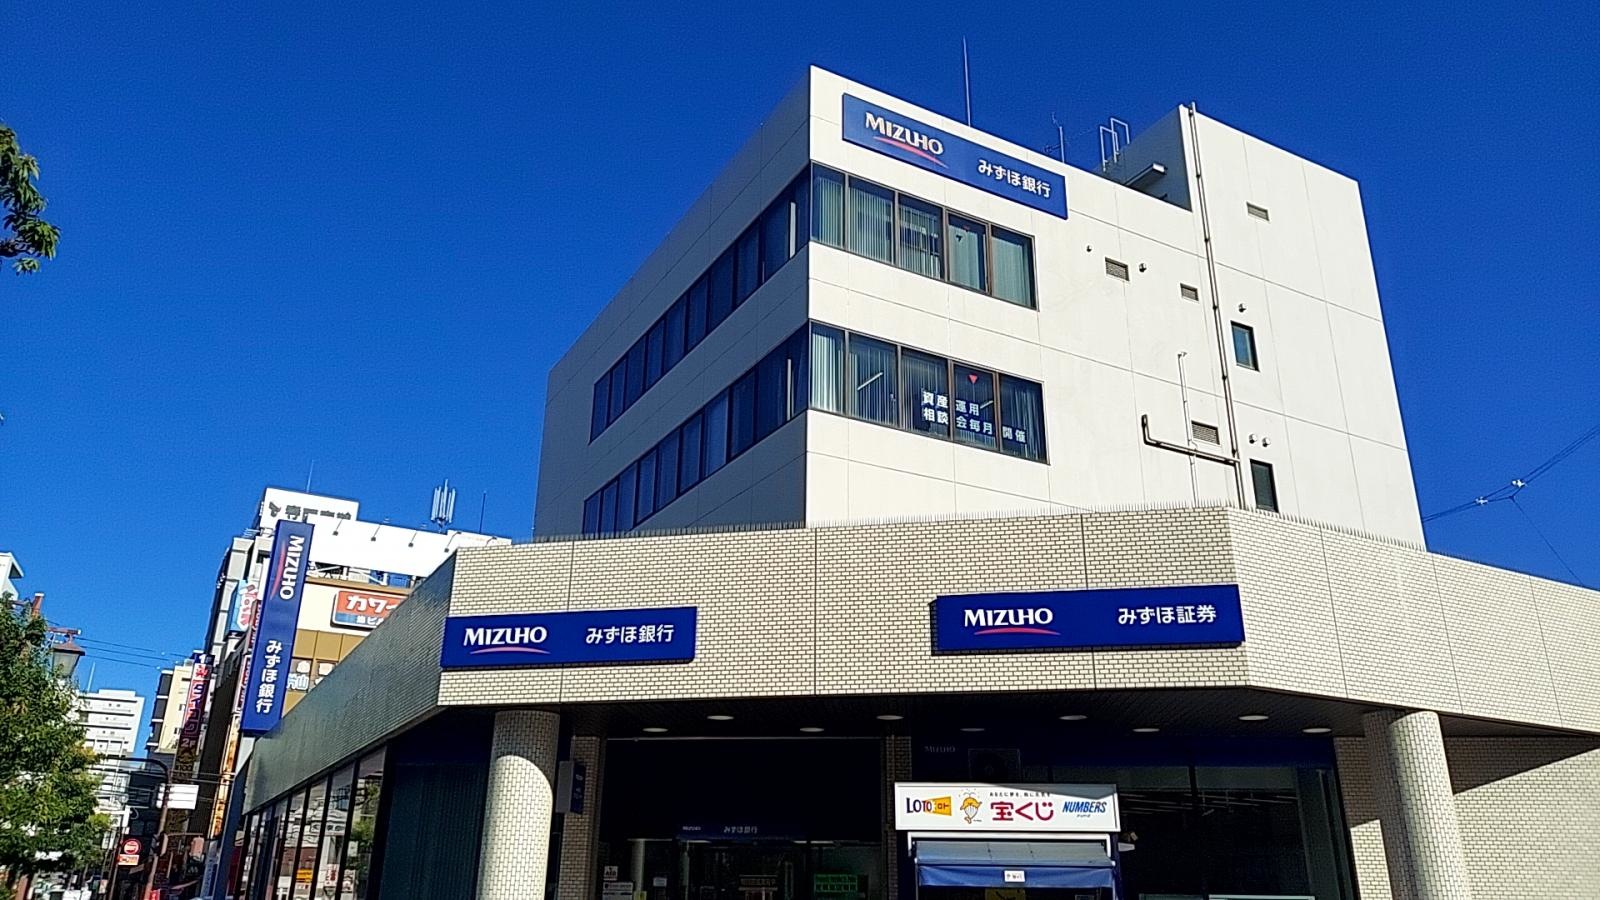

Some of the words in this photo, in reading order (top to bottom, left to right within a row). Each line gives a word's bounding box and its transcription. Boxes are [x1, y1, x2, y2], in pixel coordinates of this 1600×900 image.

[864, 111, 944, 155] MIZUHO
[978, 158, 1051, 199] みずほ銀行
[921, 390, 980, 417] 資産運用
[279, 535, 305, 600] MIZUHO
[964, 607, 1053, 627] MIZUHO
[1118, 604, 1217, 625] みずほ証券
[463, 626, 548, 646] MIZUHO
[585, 624, 675, 645] みずほ銀行
[255, 639, 283, 714] みずほ銀行
[905, 797, 932, 814] LOTO
[990, 801, 1054, 821] 宝くじ
[1062, 801, 1108, 814] NUMBERS
